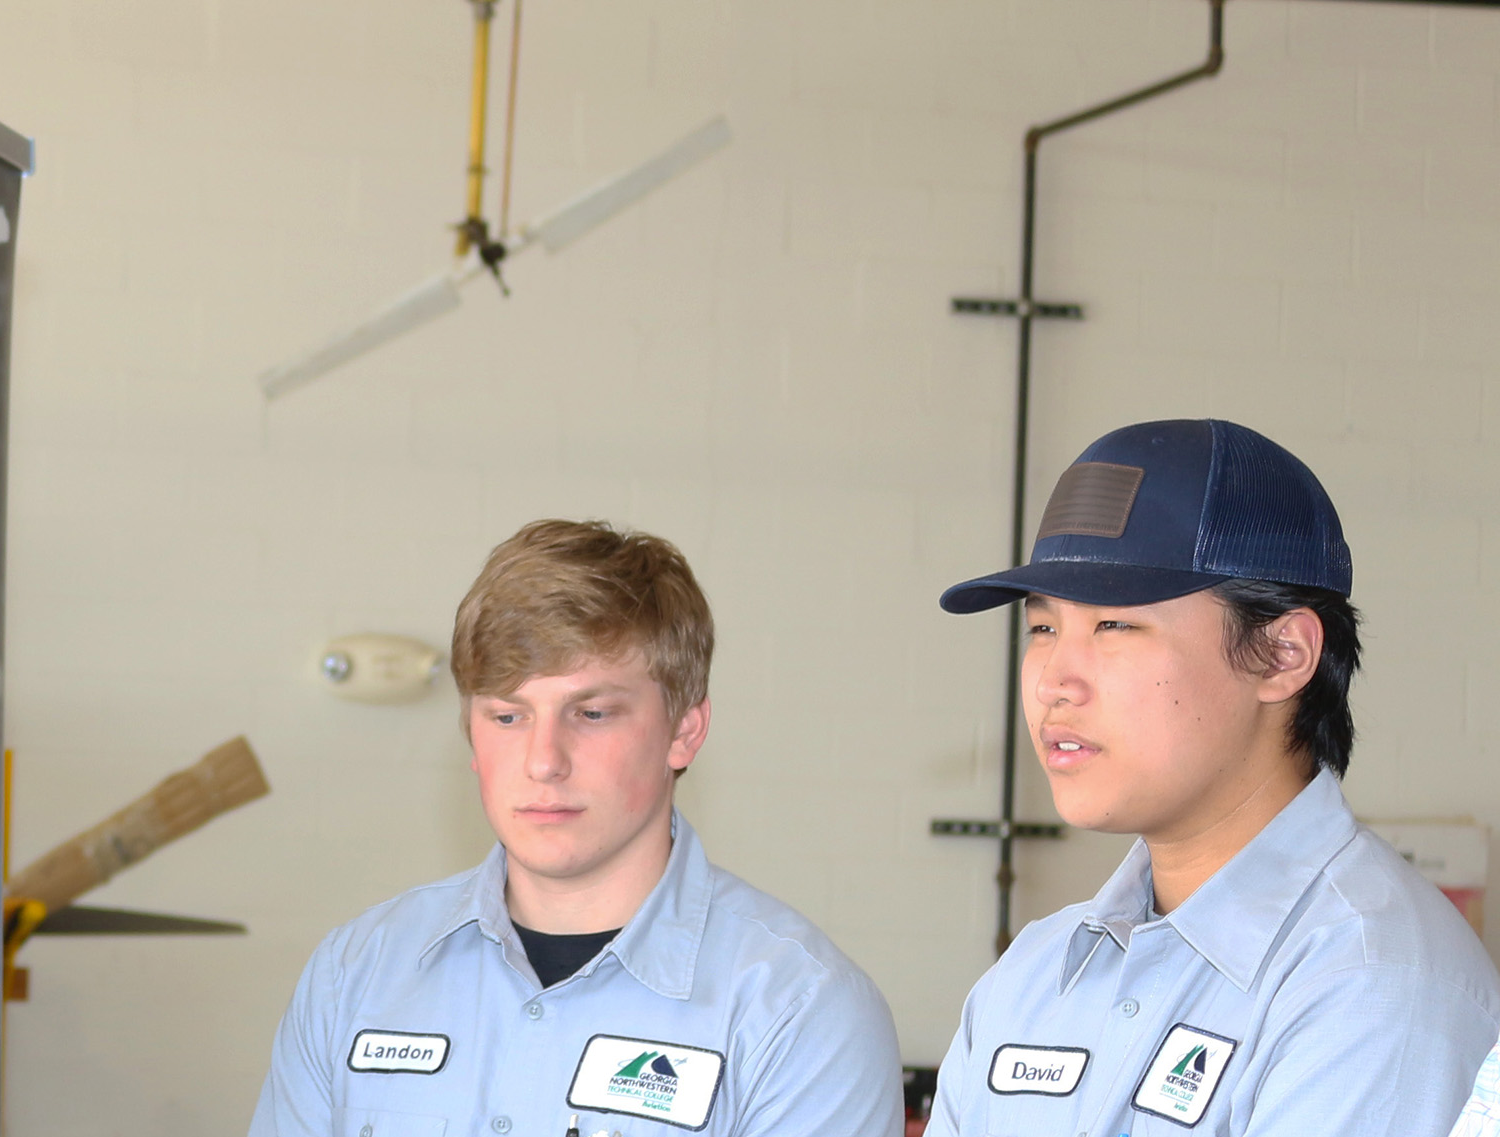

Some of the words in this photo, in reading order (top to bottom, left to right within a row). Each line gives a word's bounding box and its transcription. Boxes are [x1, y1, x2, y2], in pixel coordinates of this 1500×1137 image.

[363, 1042, 434, 1061] Landon
[640, 1072, 678, 1086] GEORGIA
[1011, 1061, 1065, 1083] David
[609, 1076, 678, 1095] NORTHWESTERN
